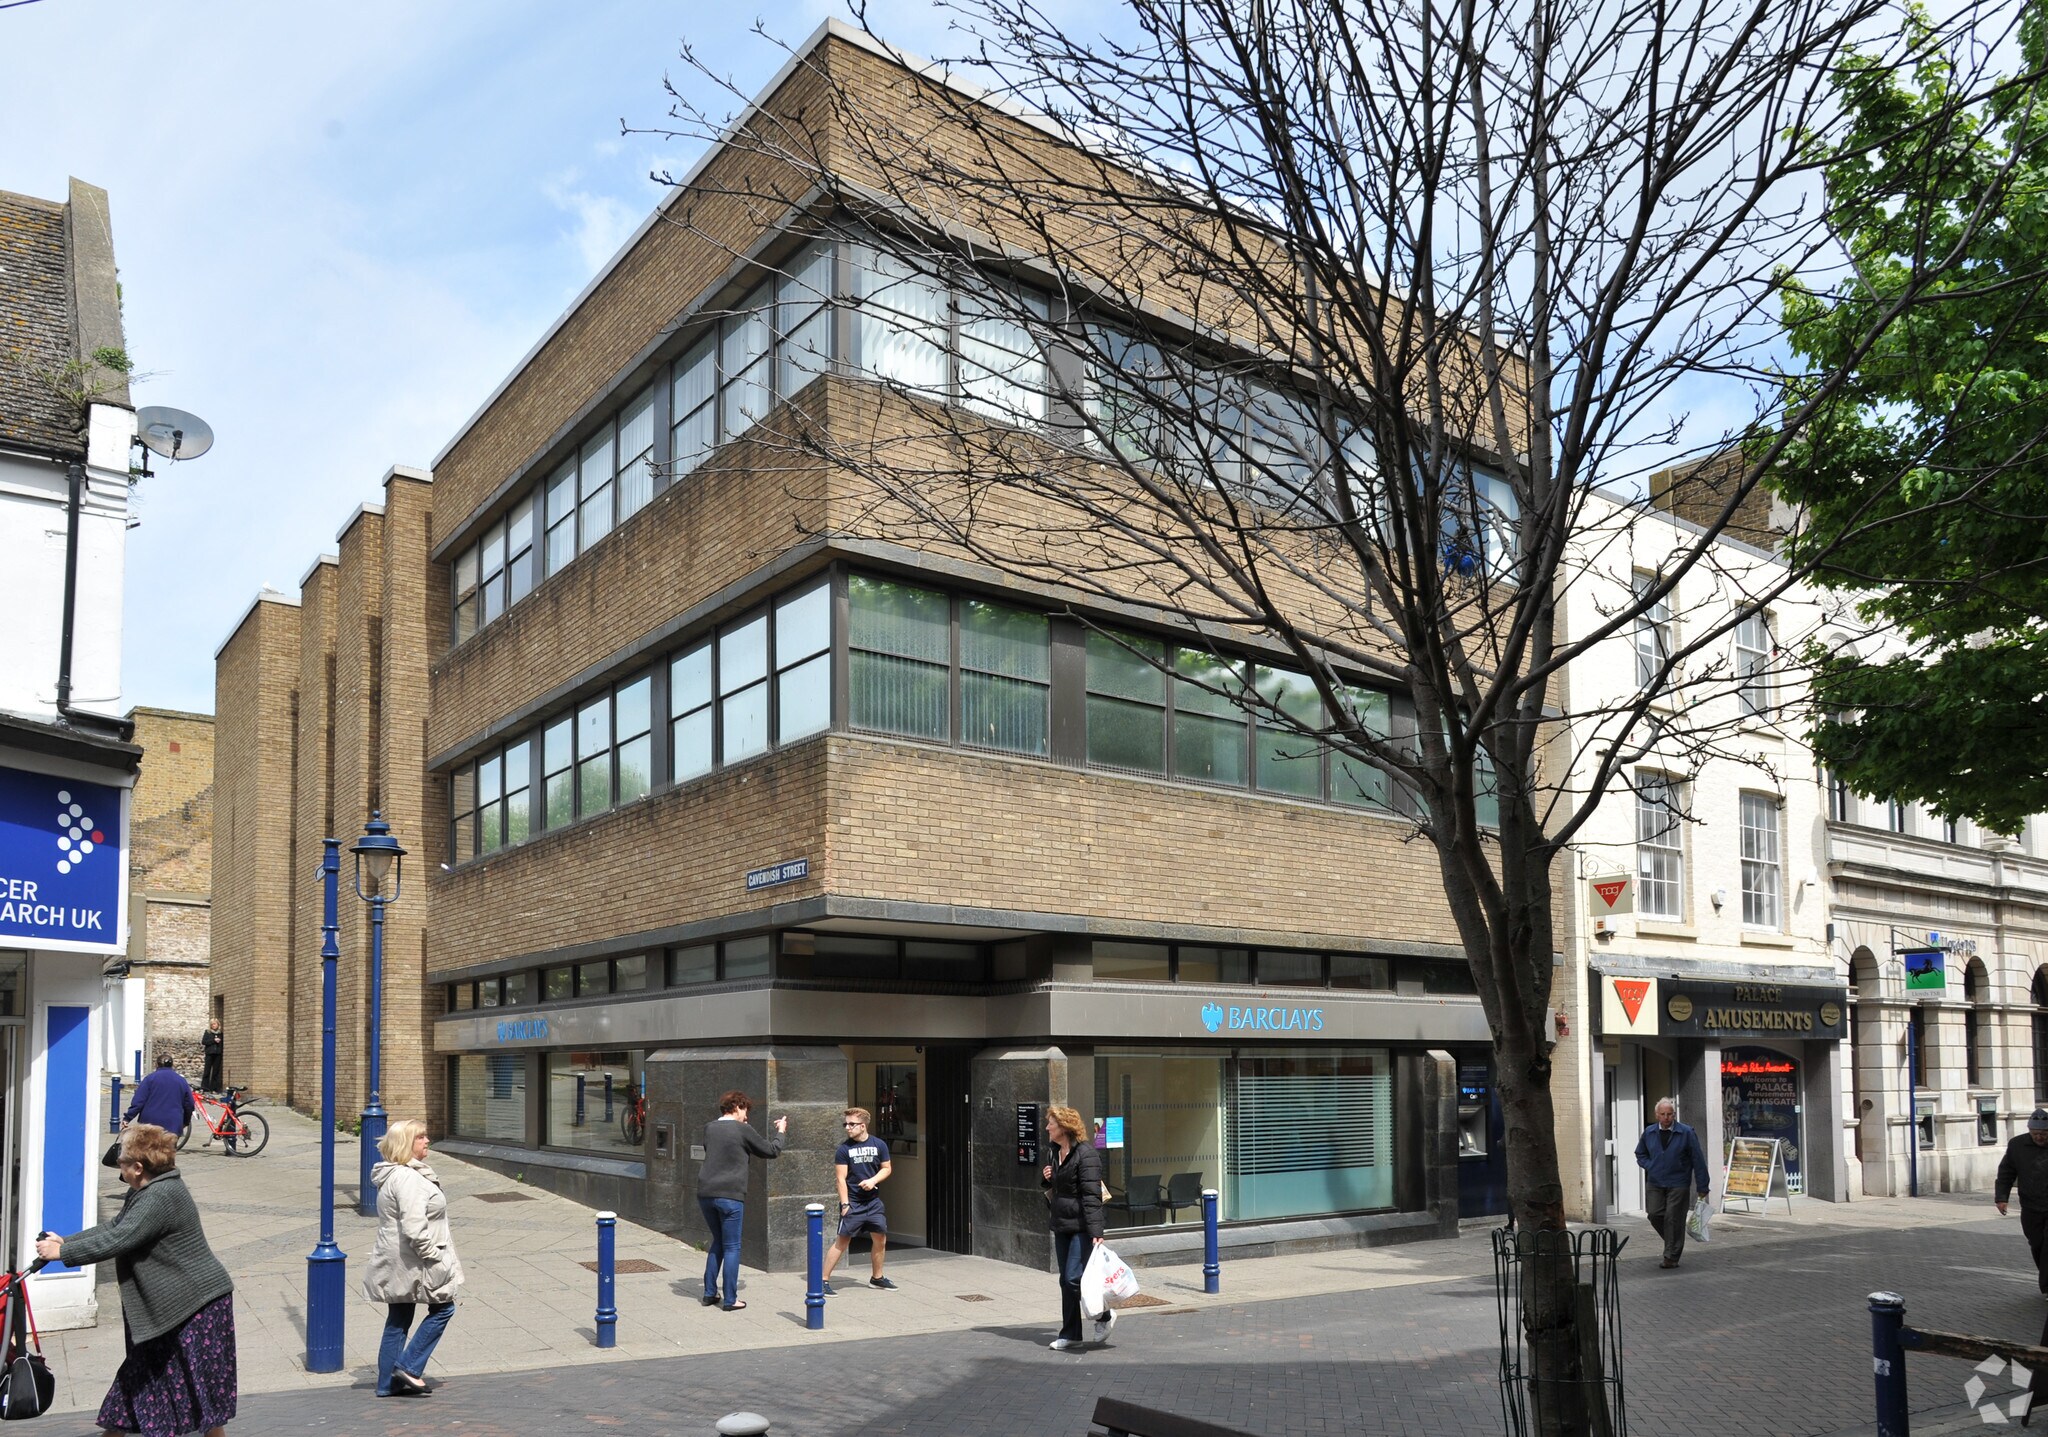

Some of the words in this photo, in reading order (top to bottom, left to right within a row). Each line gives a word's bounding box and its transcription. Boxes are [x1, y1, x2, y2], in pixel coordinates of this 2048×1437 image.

[748, 868, 780, 887] CAVENDISH
[782, 862, 806, 879] STREET
[0, 901, 65, 926] ARCH
[71, 907, 102, 930] UK
[1735, 986, 1782, 1001] PALACE
[507, 1018, 549, 1040] BARCLAYS
[1228, 1007, 1324, 1031] BARCLAYS
[1704, 1009, 1813, 1031] AMUSEMENTS
[1754, 1083, 1794, 1092] PALACE
[1749, 1098, 1797, 1106] RAMSGATE
